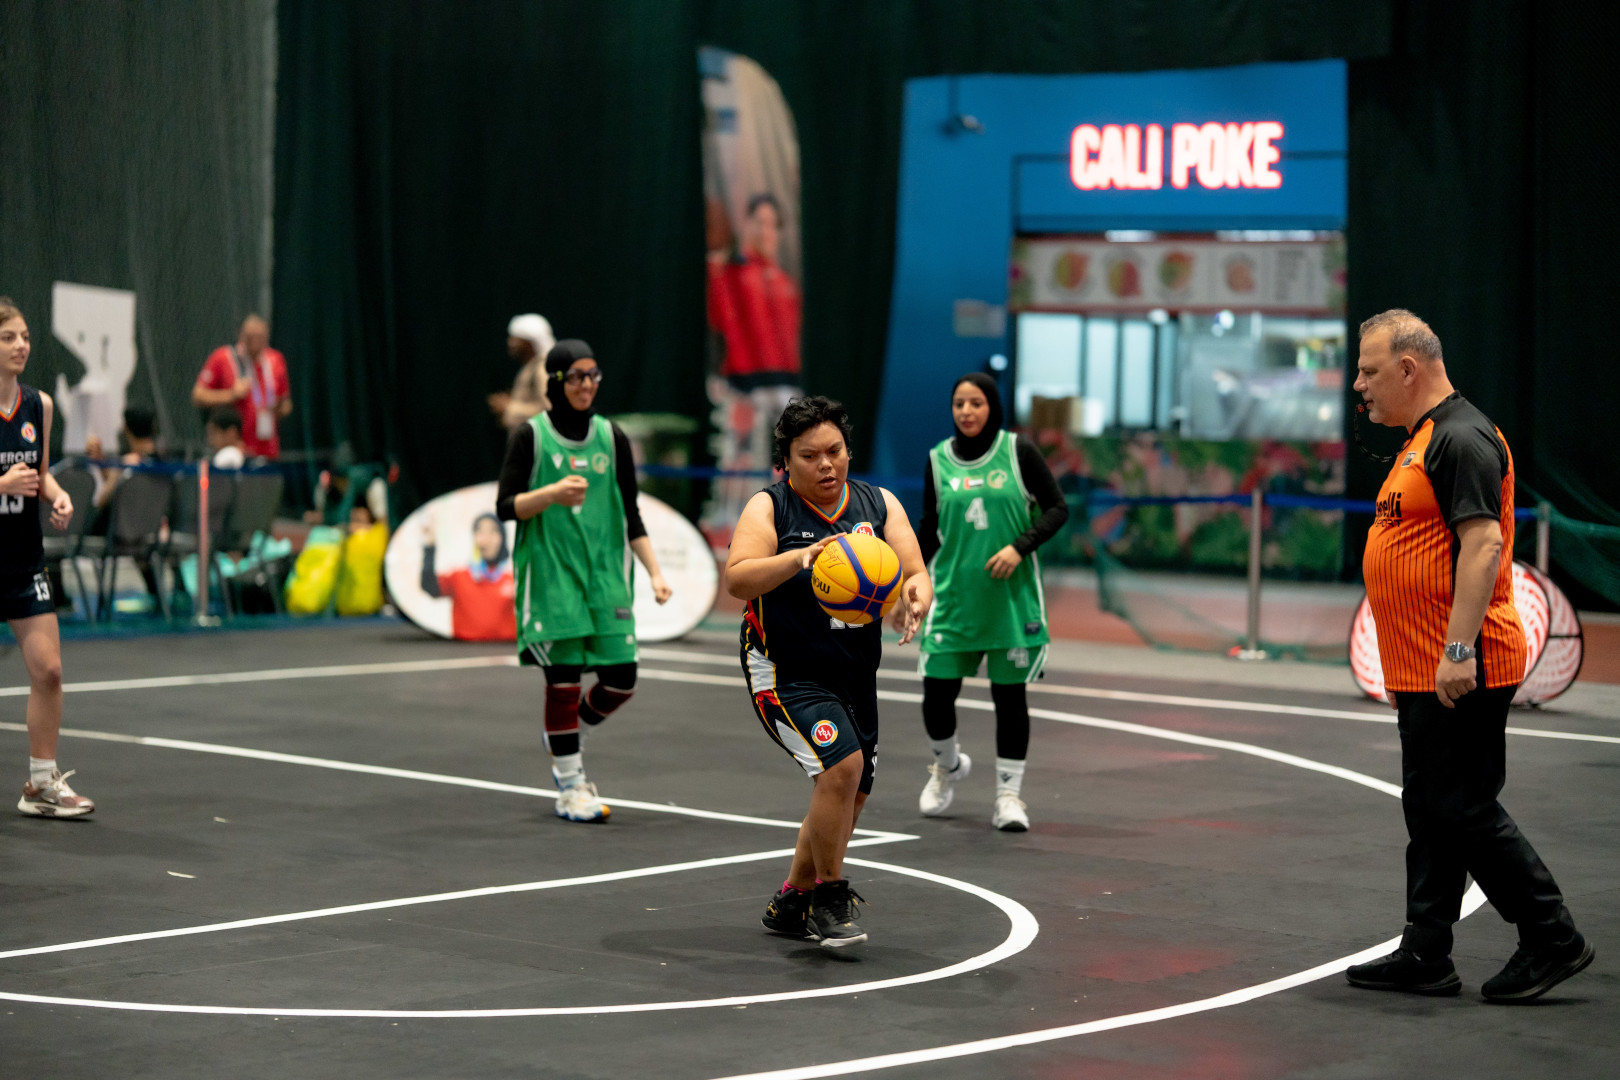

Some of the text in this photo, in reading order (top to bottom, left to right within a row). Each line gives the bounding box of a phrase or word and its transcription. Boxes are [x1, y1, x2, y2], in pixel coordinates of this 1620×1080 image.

[1070, 121, 1284, 190] CALI POKE
[965, 497, 989, 530] 4
[35, 581, 50, 601] 13
